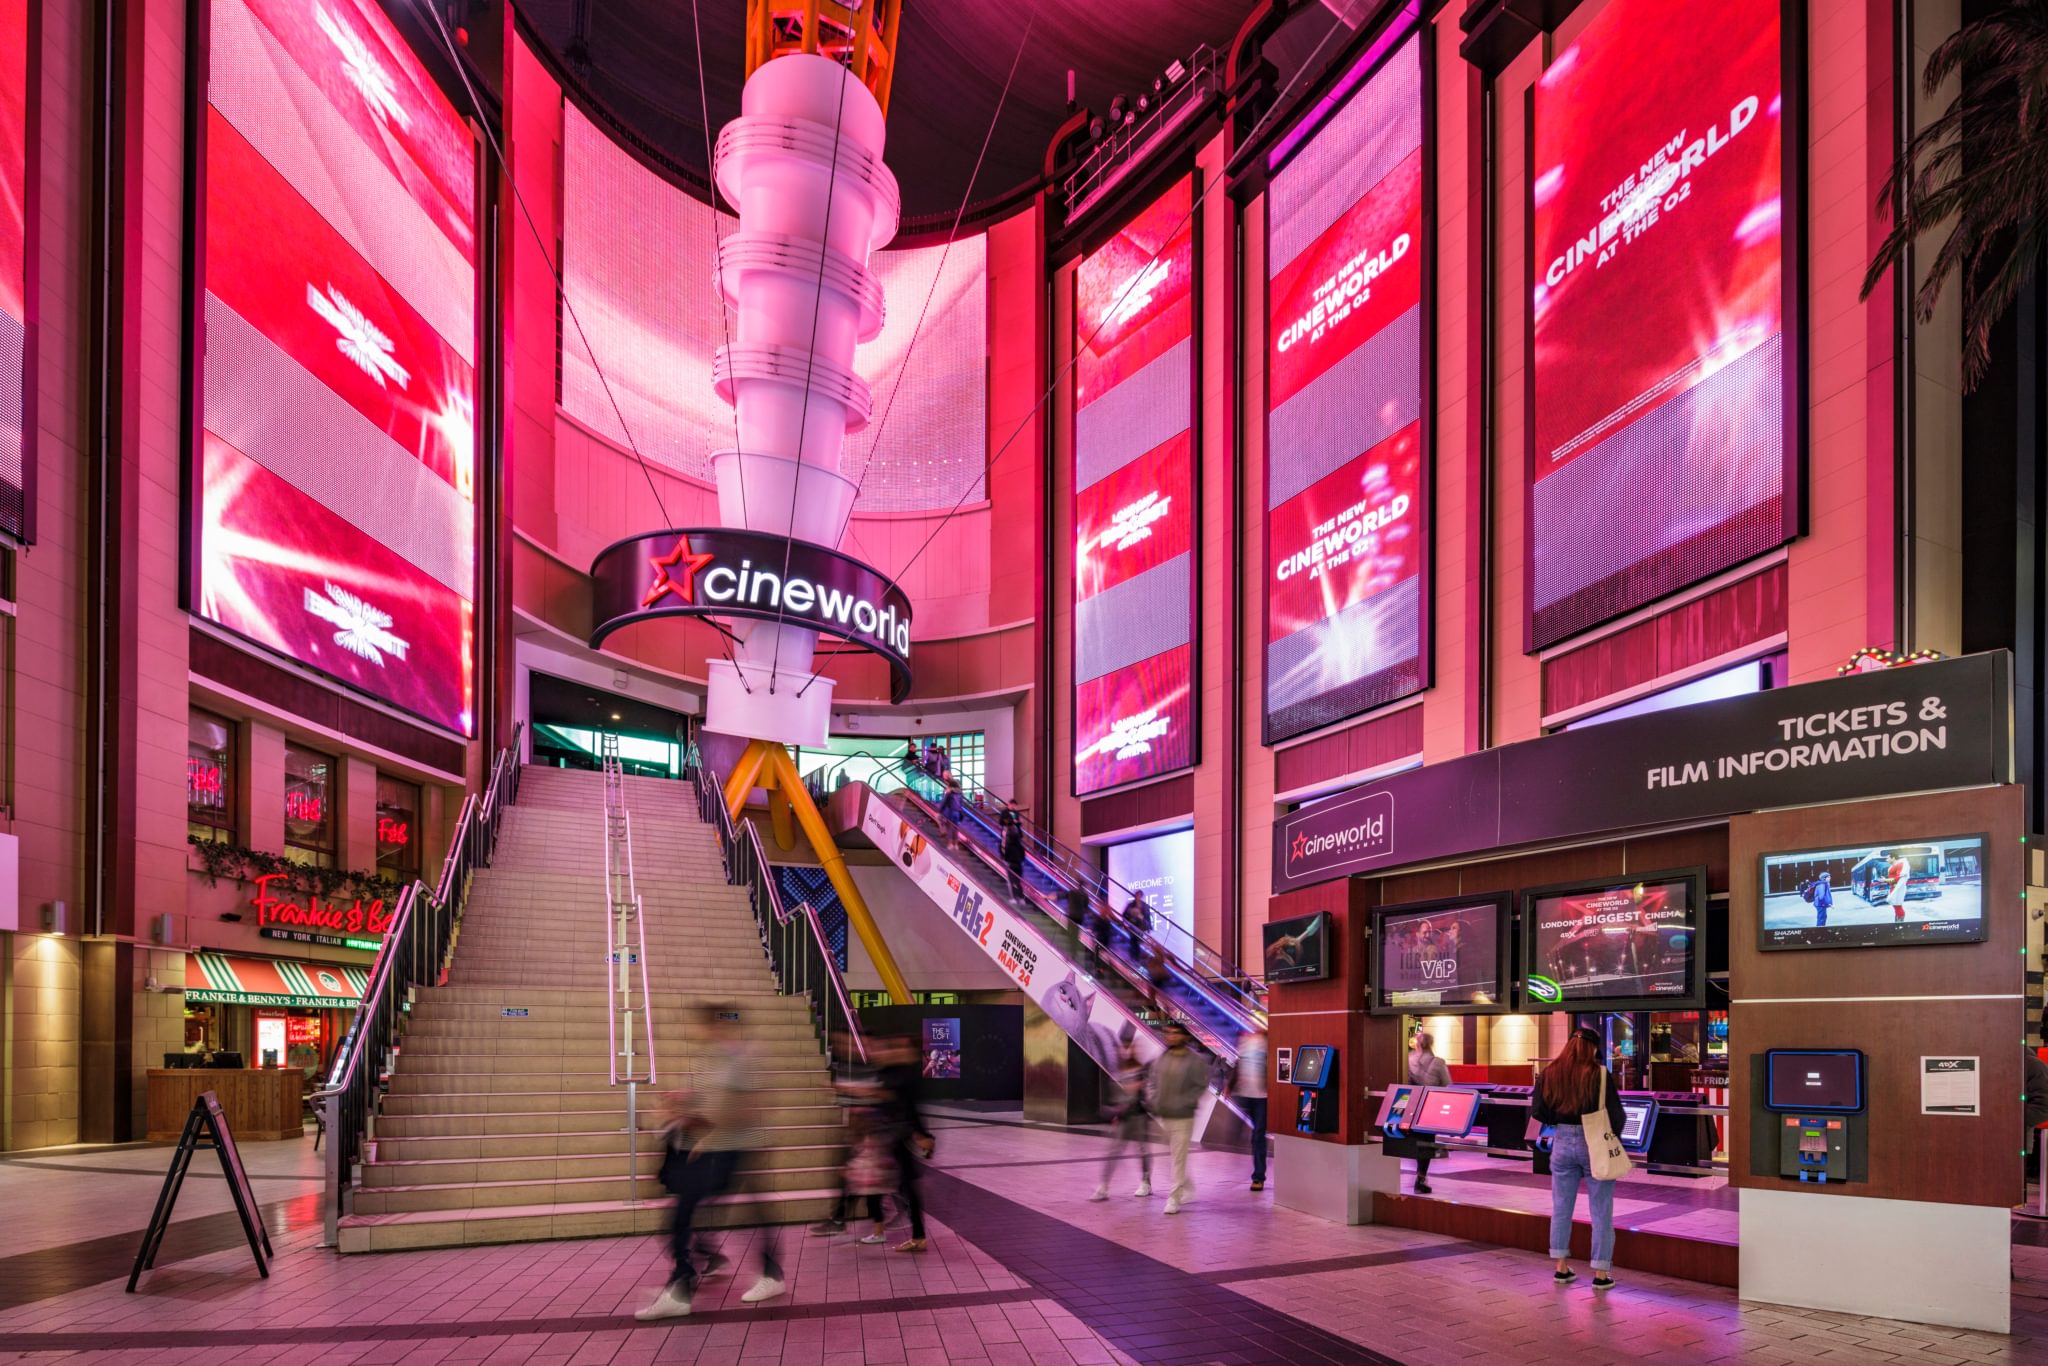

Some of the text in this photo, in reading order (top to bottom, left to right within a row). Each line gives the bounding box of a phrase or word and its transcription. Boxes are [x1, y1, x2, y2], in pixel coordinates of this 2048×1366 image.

[1600, 173, 1635, 212] THE
[1640, 128, 1686, 180] NEW
[1596, 240, 1618, 269] AT
[1623, 206, 1659, 245] THE
[1277, 233, 1410, 352] CINEWORLD
[1312, 248, 1367, 302] THE NEW
[1310, 323, 1326, 344] AT
[1327, 303, 1351, 329] THE
[1276, 495, 1409, 581] CINEWORLD
[1312, 499, 1367, 539] THE NEW
[1309, 562, 1325, 580] AT
[1327, 549, 1350, 570] THE
[703, 560, 910, 658] cineworld
[1777, 696, 1947, 741] TICKETS &
[1647, 725, 1947, 790] FILM INFORMATION
[1305, 813, 1384, 856] cineworld
[1337, 838, 1383, 854] CINEMAS
[252, 873, 343, 930] Frankie
[1128, 875, 1174, 890] WELCOME TO
[1540, 909, 1682, 929] LONDON'S BIGGEST CINEMA
[1585, 899, 1630, 909] CINEWORLD
[272, 930, 288, 939] NEW
[293, 931, 312, 942] YORK
[316, 935, 342, 945] ITALIAN
[979, 911, 994, 946] 2
[1005, 929, 1037, 963] CINEWORLD
[997, 949, 1031, 988] MAY 24
[1001, 940, 1010, 953] AT
[1011, 949, 1024, 965] THE
[185, 991, 237, 1003] FRANKIE
[238, 994, 247, 1003] &
[248, 995, 292, 1006] BENNY'S
[296, 997, 338, 1007] FRANKIE
[338, 999, 345, 1007] &
